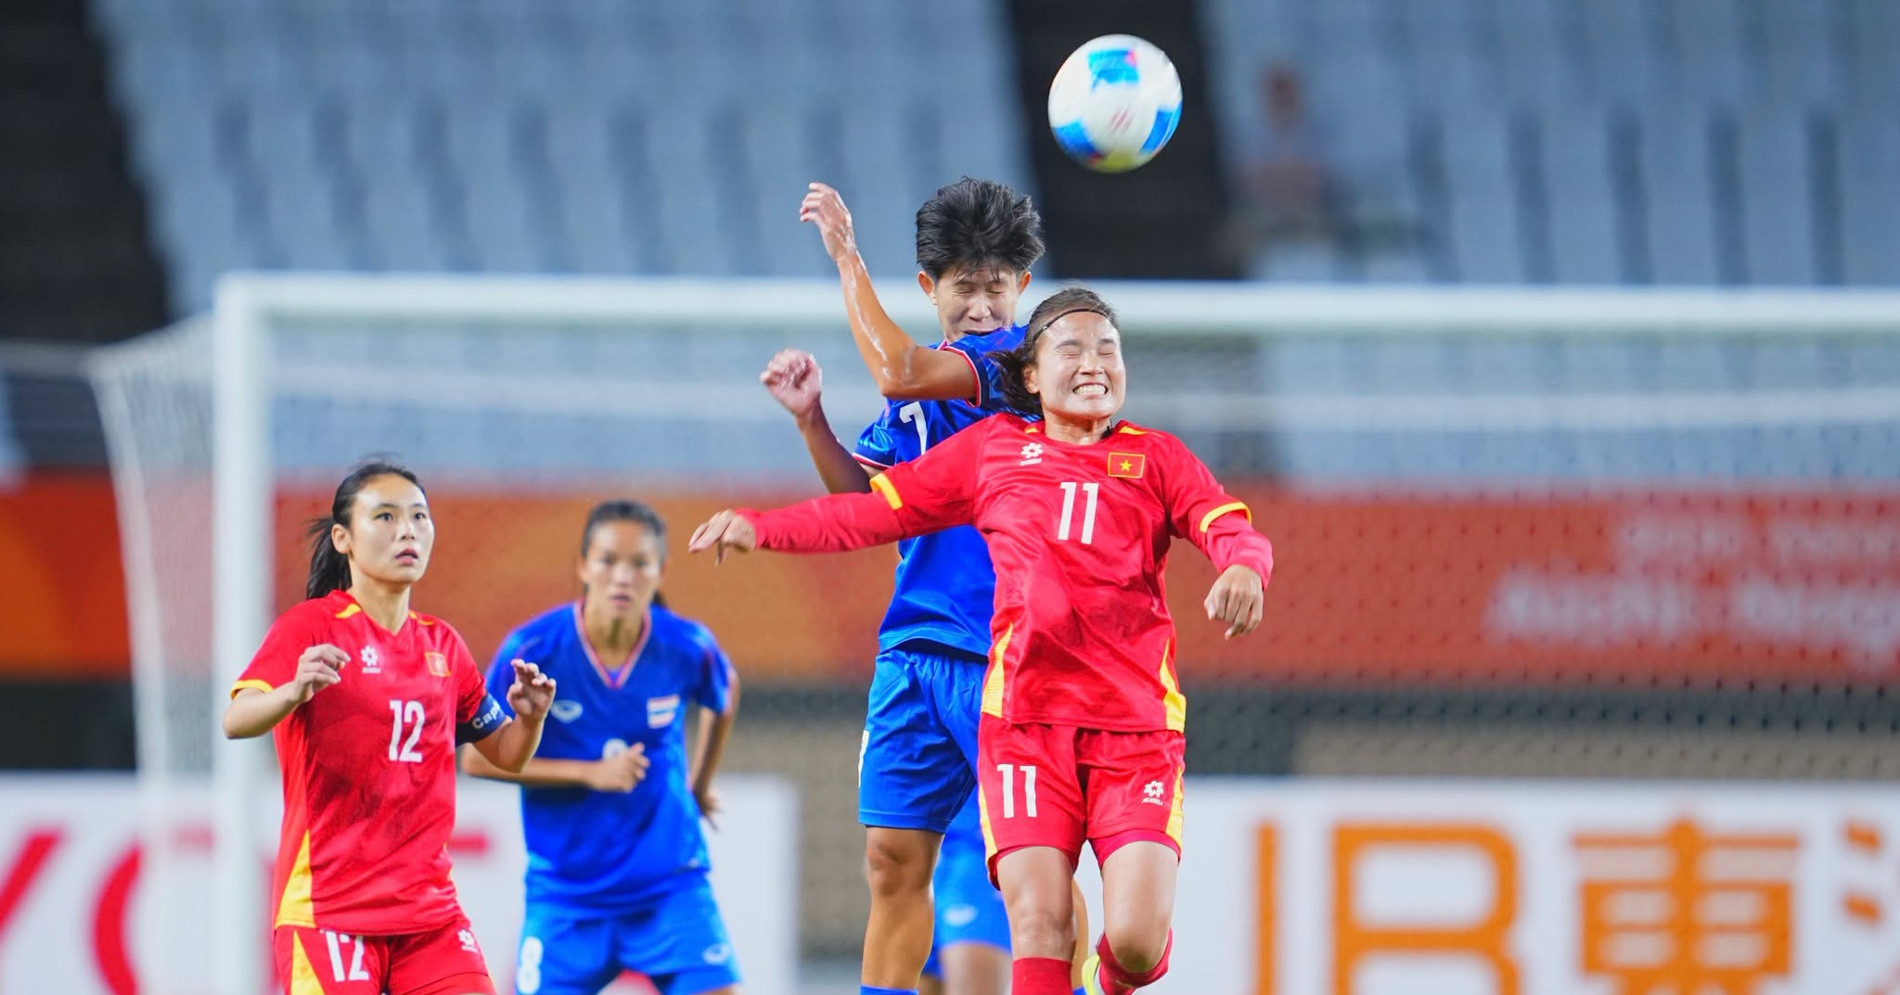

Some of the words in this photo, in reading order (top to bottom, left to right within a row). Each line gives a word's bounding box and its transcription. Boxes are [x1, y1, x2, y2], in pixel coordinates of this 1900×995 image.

[899, 401, 928, 455] 7
[1058, 481, 1099, 545] 11
[389, 699, 425, 763] 12
[996, 763, 1037, 818] 11
[324, 930, 369, 982] 12
[515, 935, 544, 995] 8
